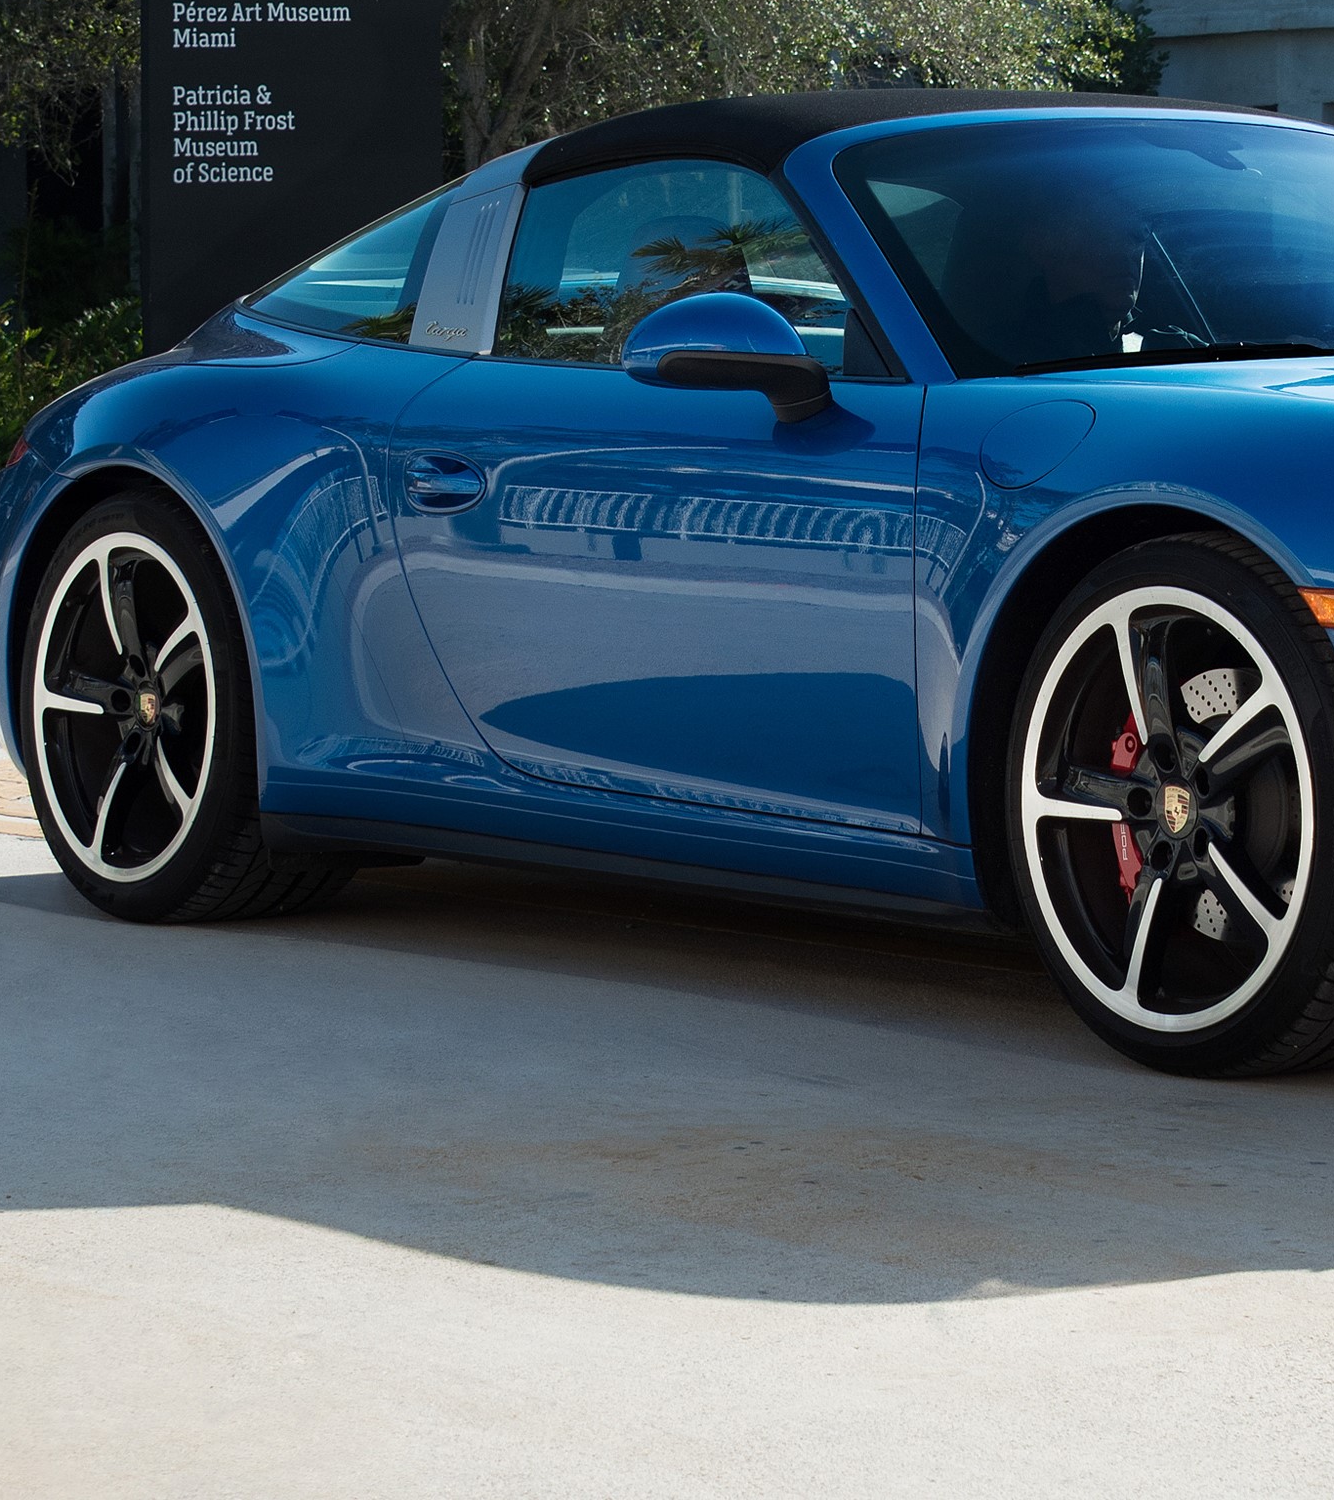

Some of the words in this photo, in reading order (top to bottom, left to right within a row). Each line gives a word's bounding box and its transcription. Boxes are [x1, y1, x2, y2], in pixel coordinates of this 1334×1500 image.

[172, 1, 228, 23] Pérez
[231, 2, 263, 22] Art
[266, 2, 352, 22] Museum
[172, 28, 237, 48] Miami
[172, 85, 252, 106] Patricia
[256, 85, 272, 105] &
[173, 111, 239, 136] Phillip
[243, 111, 296, 131] Frost
[173, 137, 259, 157] Museum
[173, 163, 195, 184] of
[198, 162, 274, 182] Science
